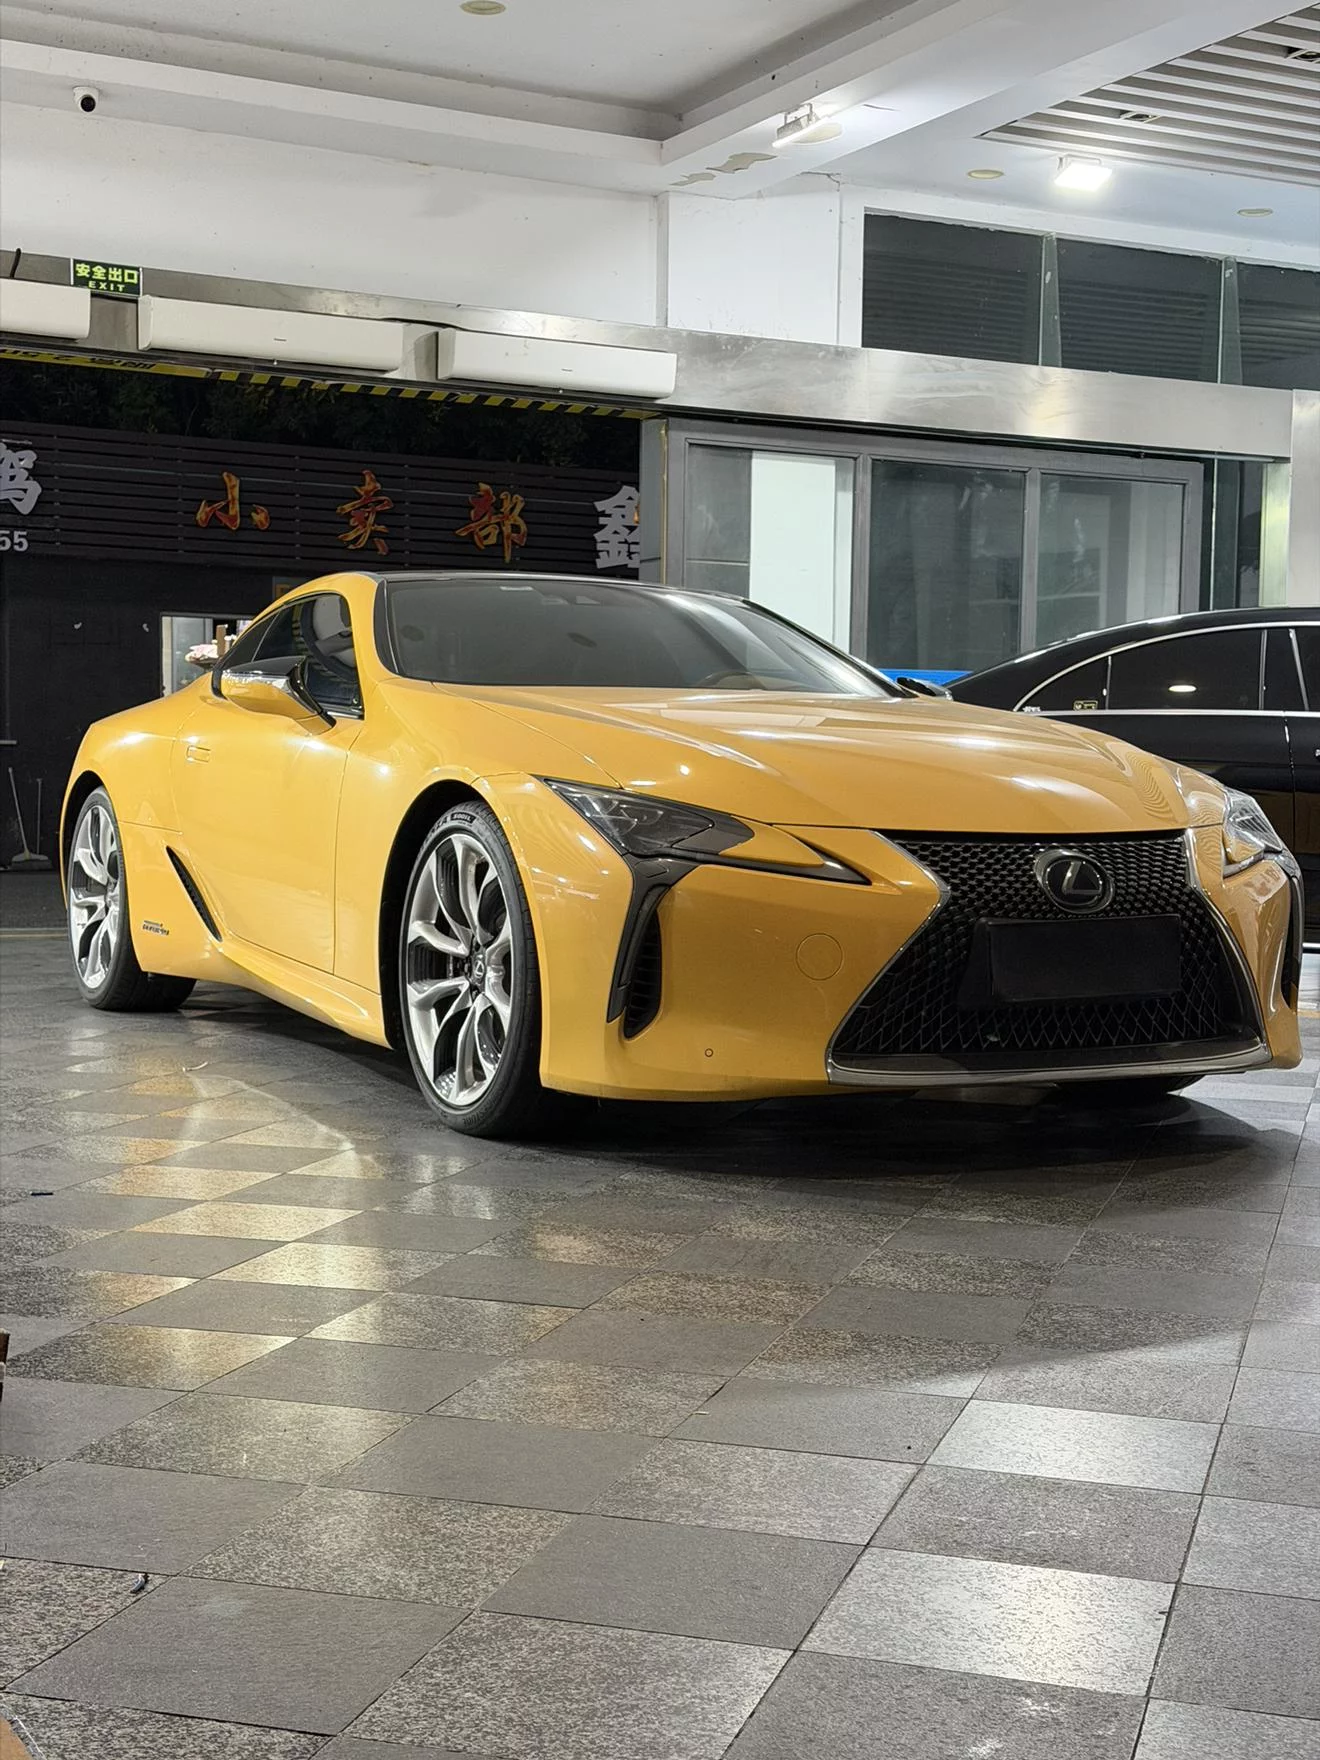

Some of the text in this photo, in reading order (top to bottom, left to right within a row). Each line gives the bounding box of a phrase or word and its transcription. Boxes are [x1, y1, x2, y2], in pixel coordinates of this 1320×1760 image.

[75, 263, 139, 284] 安全出口
[88, 280, 125, 292] EXIT
[195, 470, 528, 563] 小卖部
